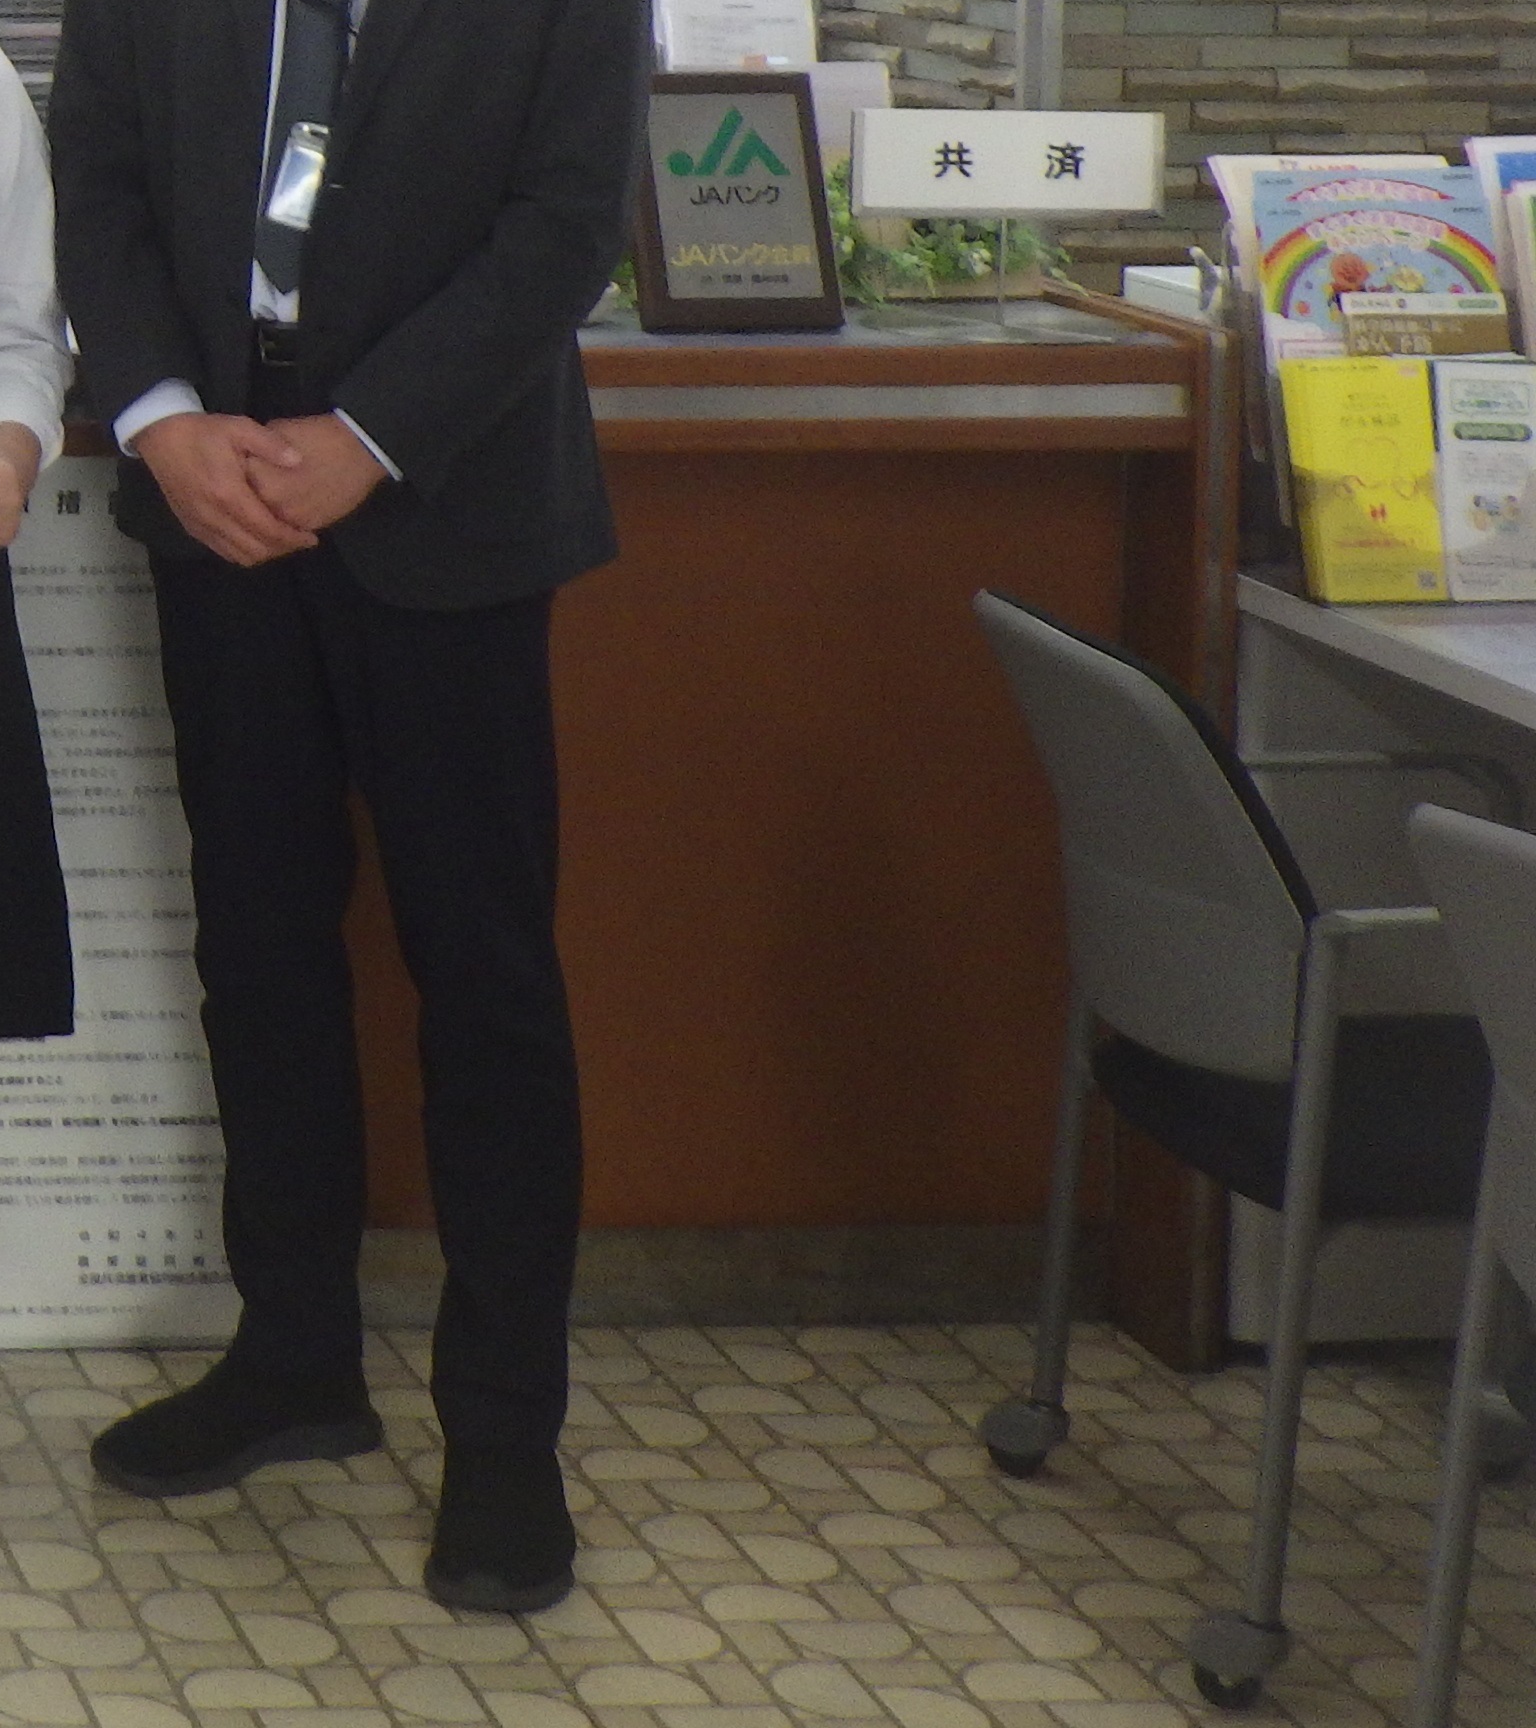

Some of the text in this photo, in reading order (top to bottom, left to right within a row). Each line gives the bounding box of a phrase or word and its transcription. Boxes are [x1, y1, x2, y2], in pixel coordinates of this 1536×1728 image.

[934, 141, 1086, 180] 共済
[689, 185, 781, 206] JAバンク
